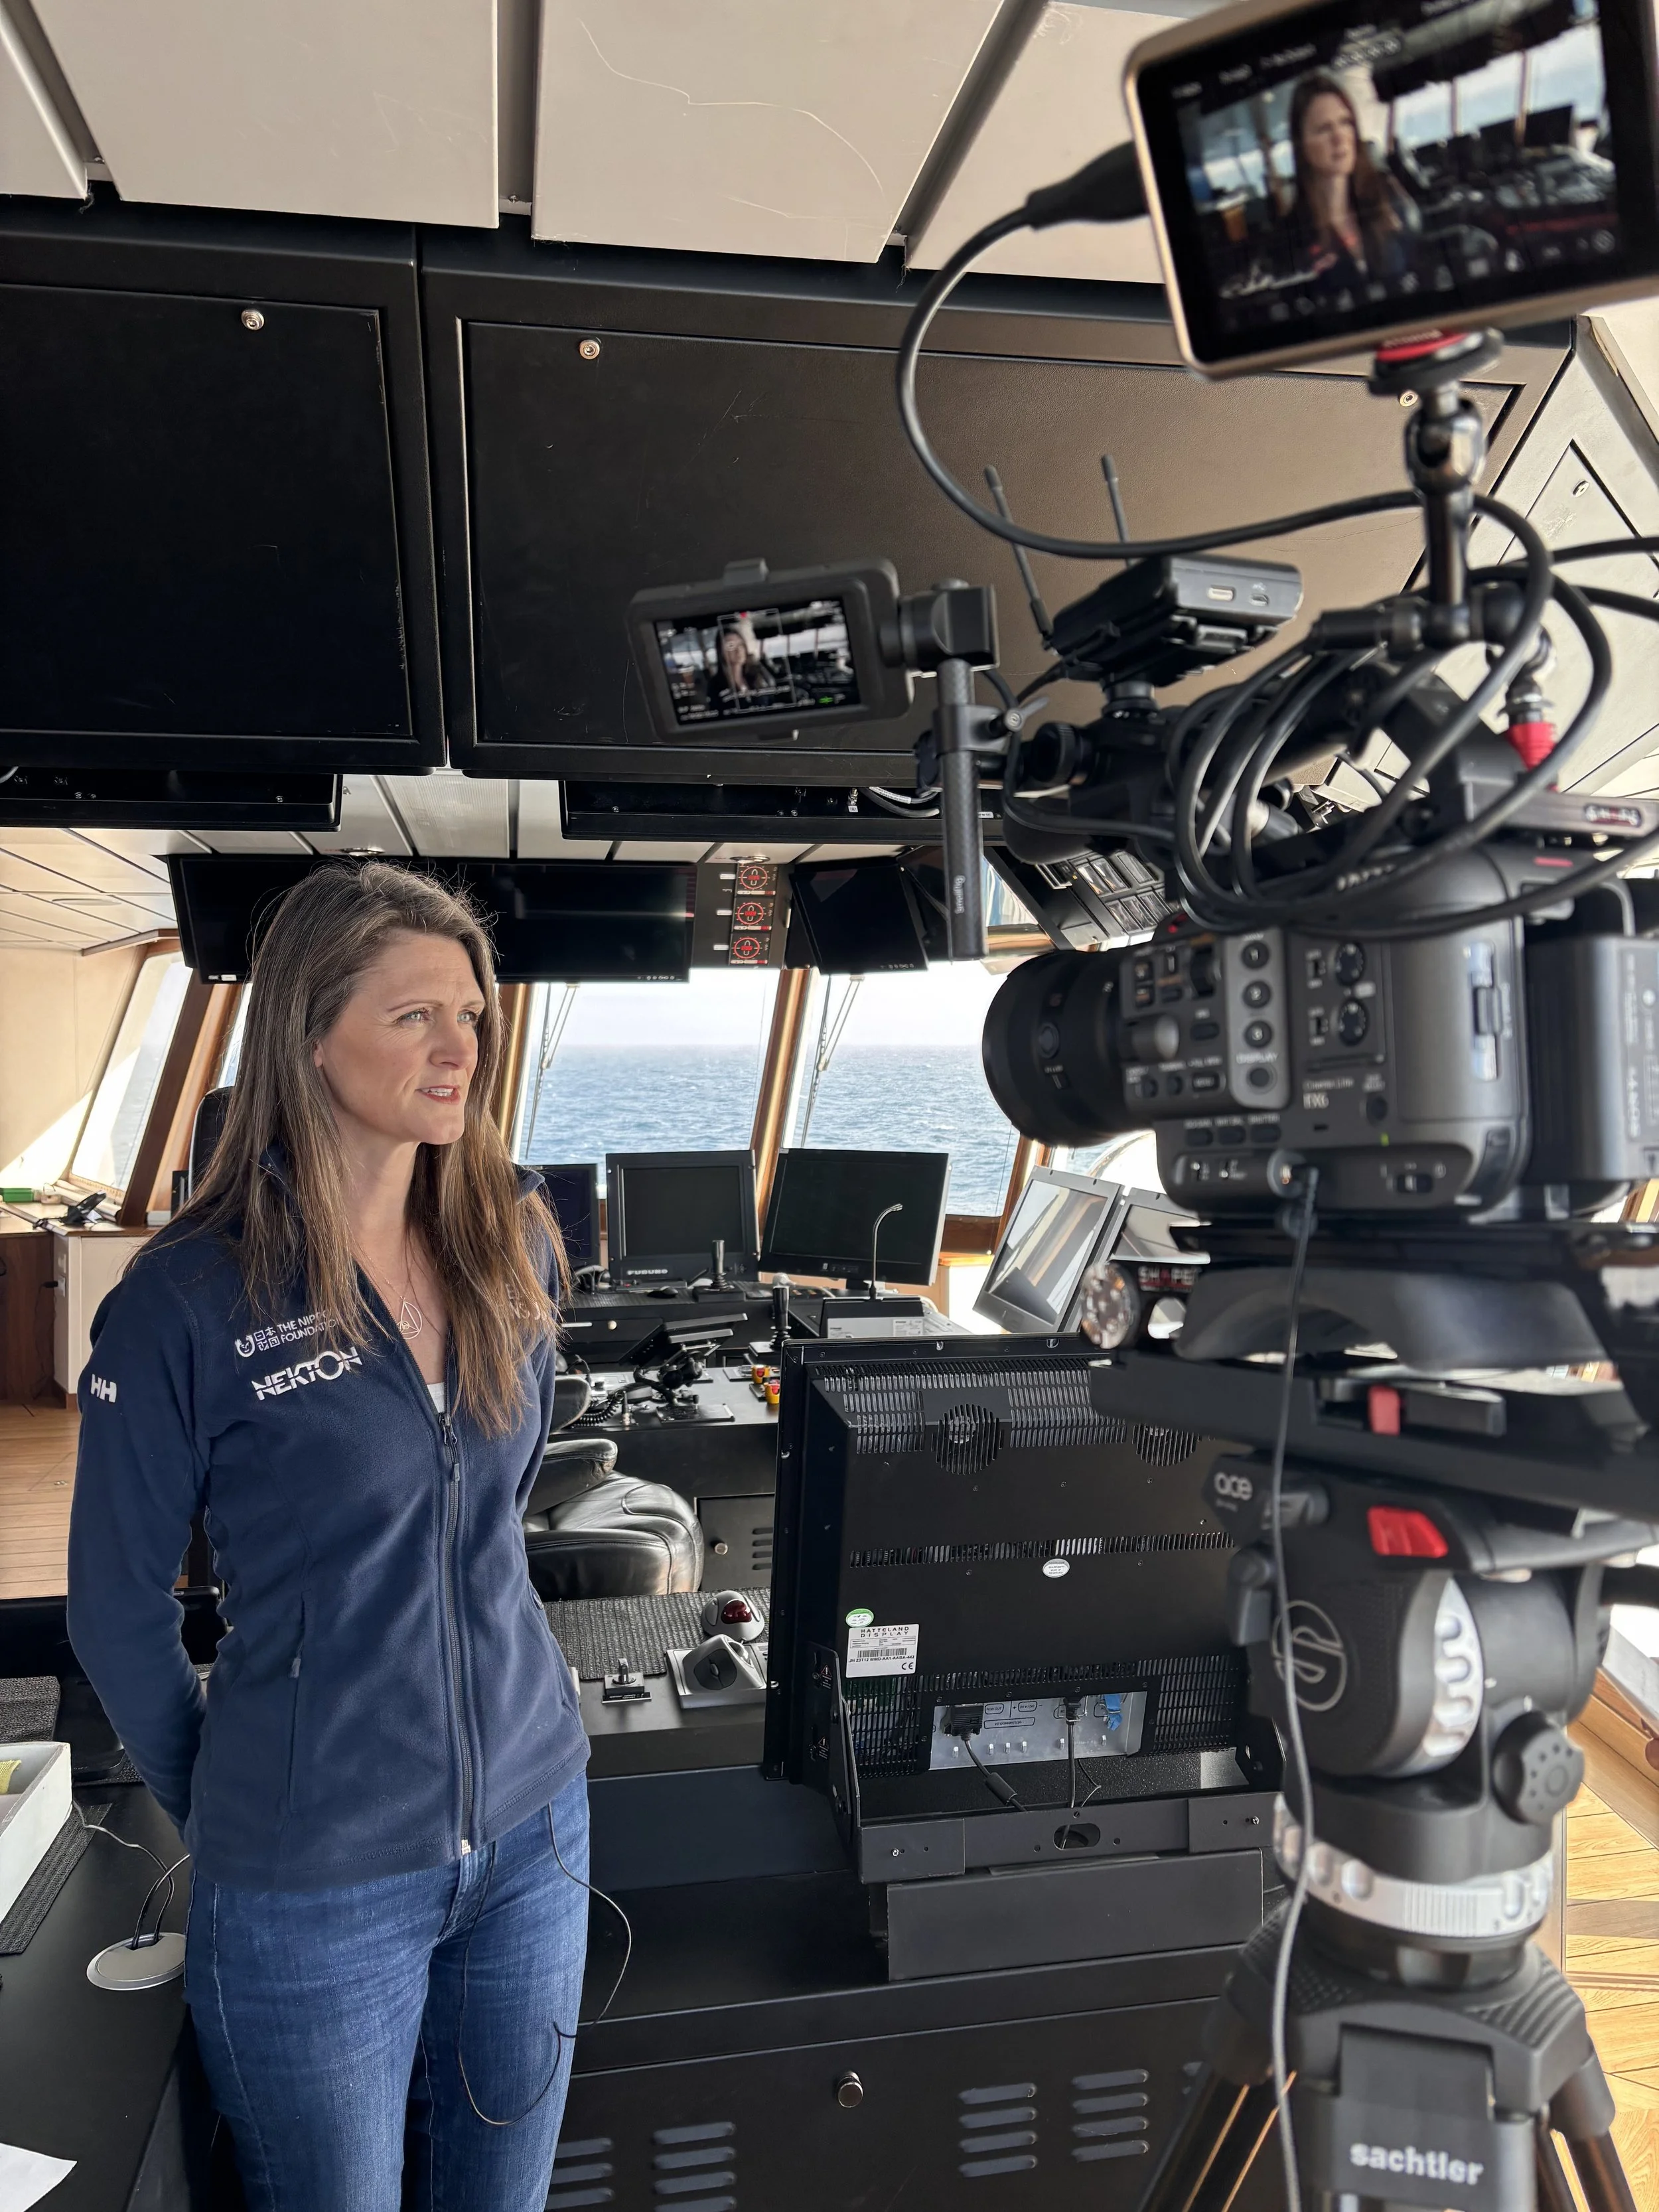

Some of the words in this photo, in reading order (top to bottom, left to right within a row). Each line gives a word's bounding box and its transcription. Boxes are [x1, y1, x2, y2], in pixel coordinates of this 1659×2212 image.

[277, 1321, 298, 1333] THE
[90, 1373, 117, 1402] HH
[251, 1346, 363, 1401] NEKTON
[1350, 2142, 1484, 2186] sachtler
